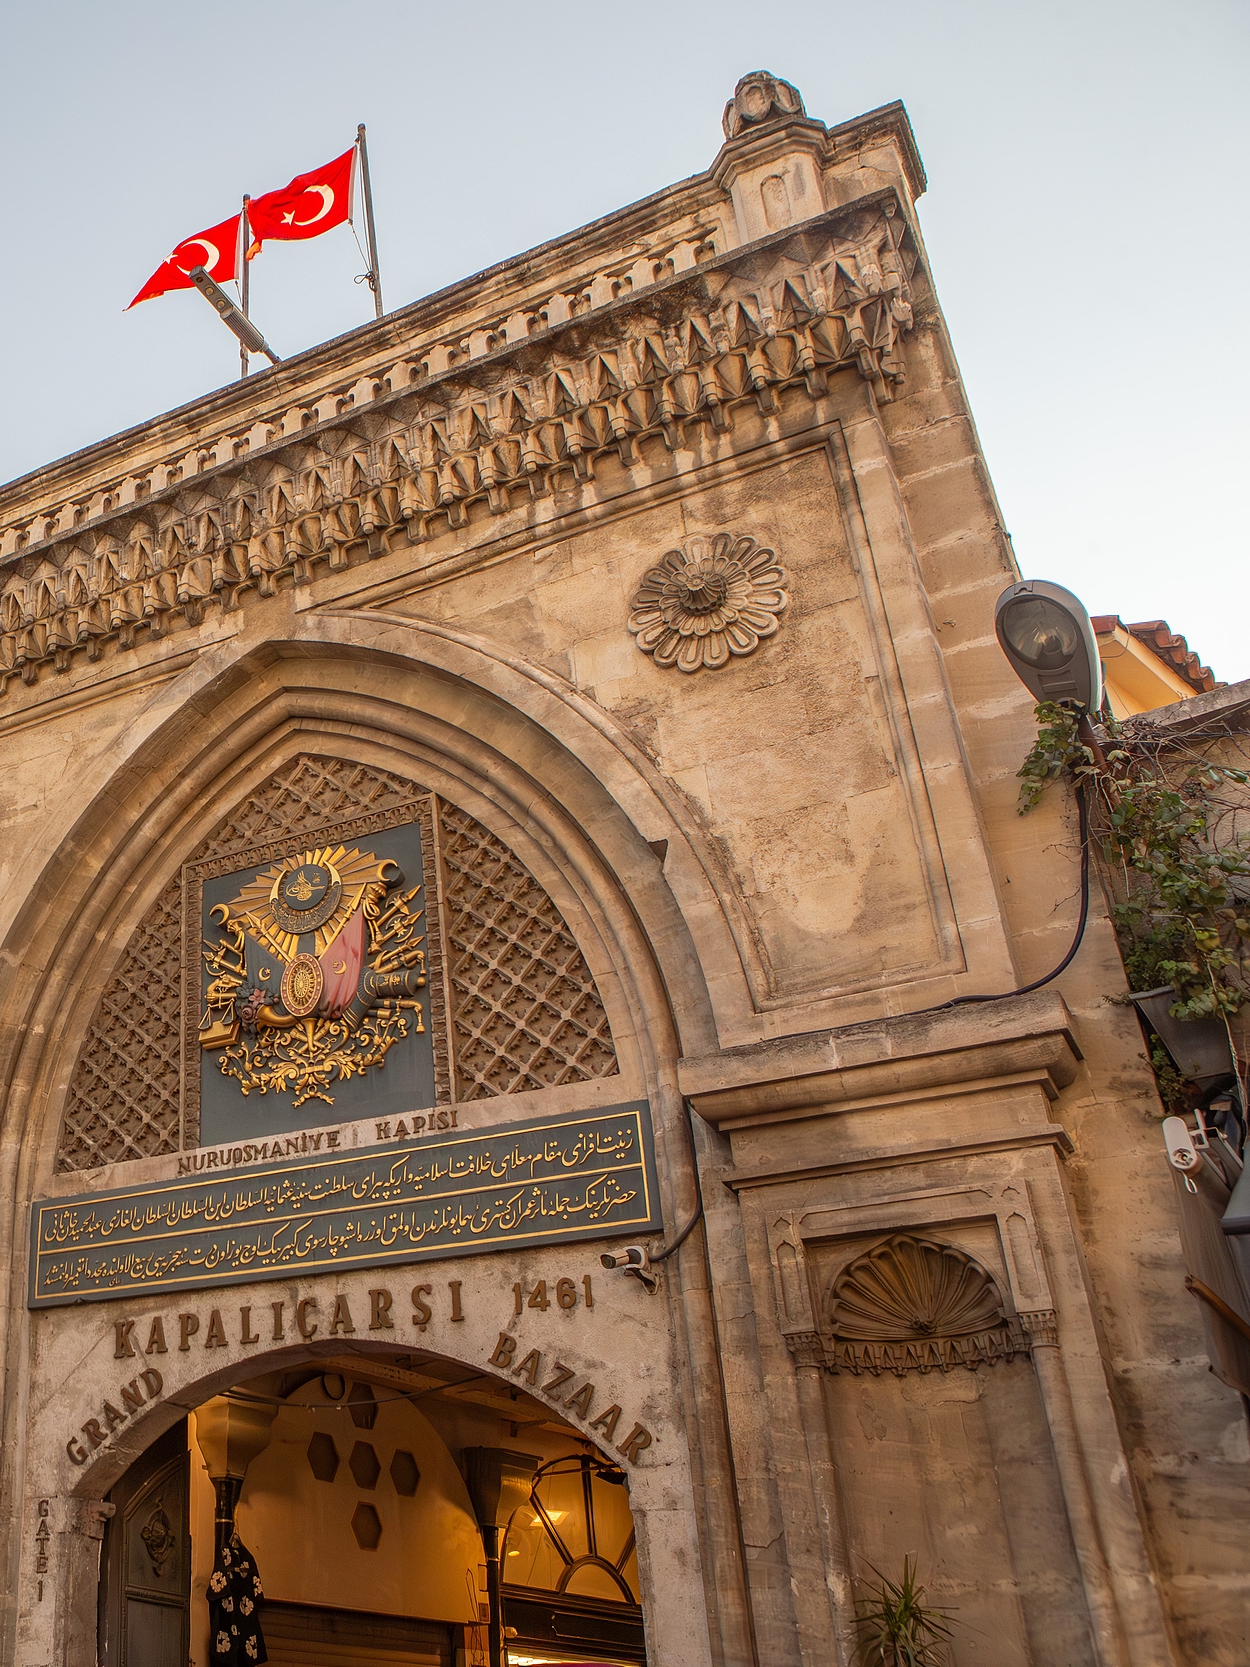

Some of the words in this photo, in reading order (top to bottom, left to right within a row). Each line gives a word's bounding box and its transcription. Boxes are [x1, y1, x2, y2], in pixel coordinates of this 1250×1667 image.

[375, 1109, 459, 1141] KAPISI
[113, 1279, 465, 1358] KAPALIÇARŞI
[512, 1274, 593, 1315] 1461
[66, 1367, 164, 1466] GRAND
[488, 1331, 652, 1465] BAZAAR
[35, 1499, 51, 1574] GATE
